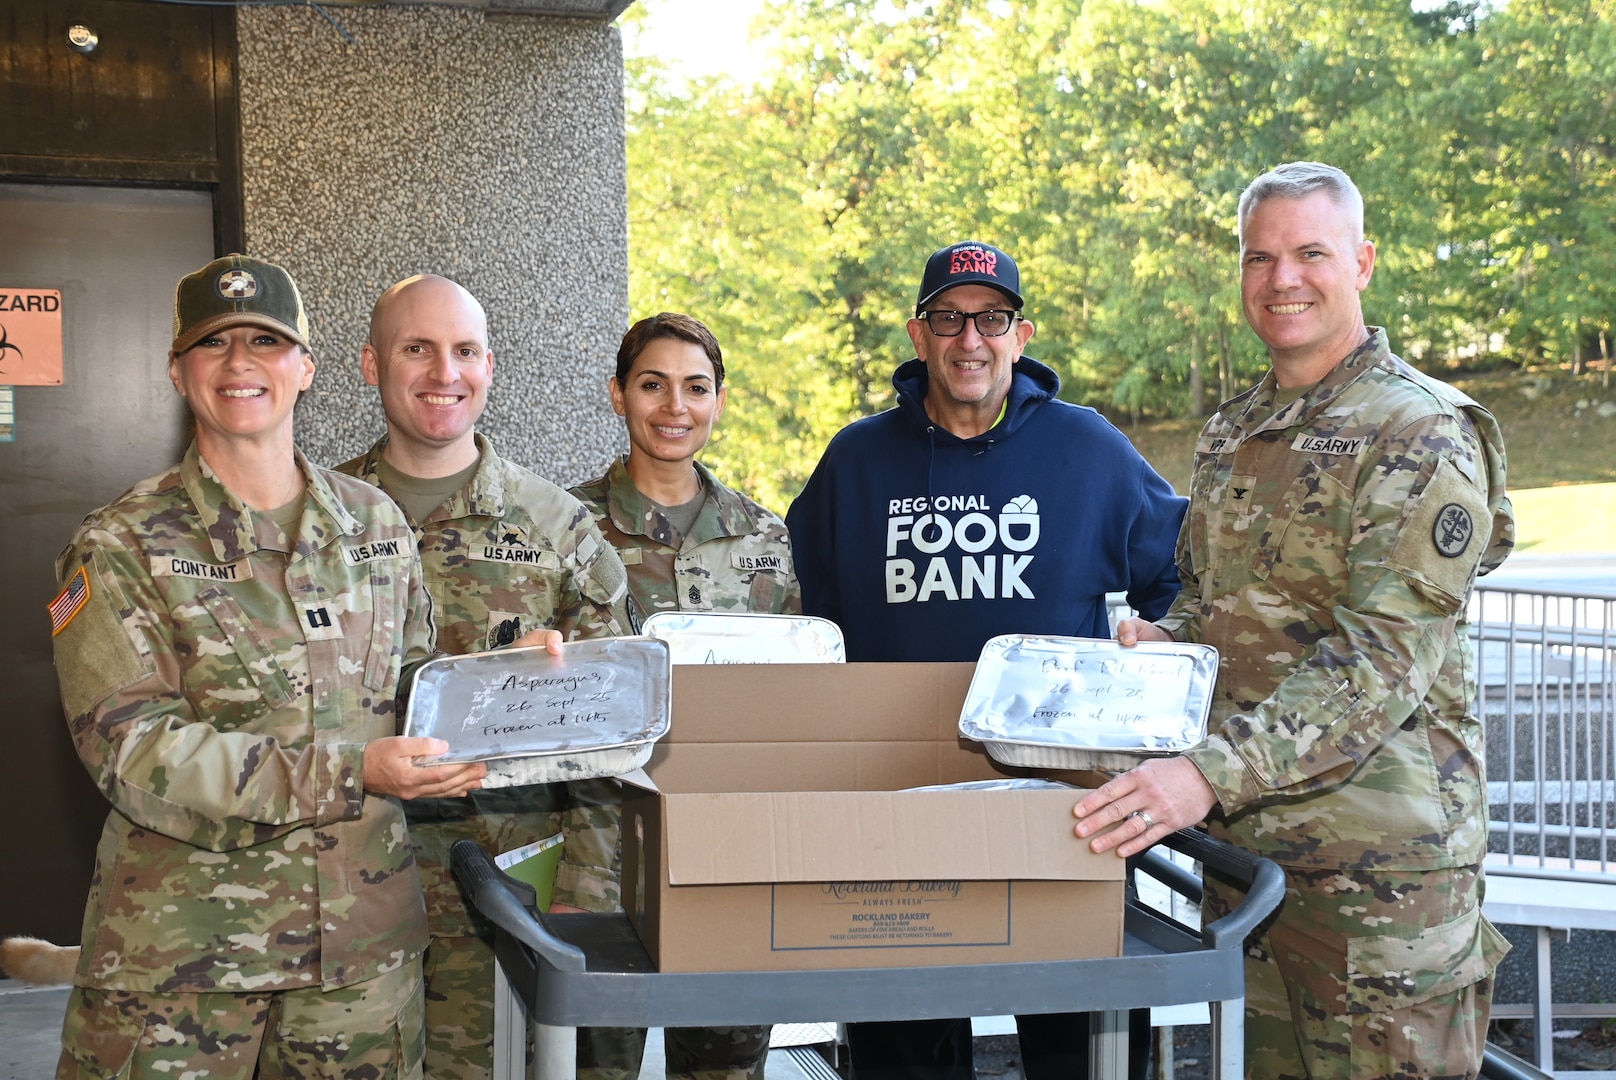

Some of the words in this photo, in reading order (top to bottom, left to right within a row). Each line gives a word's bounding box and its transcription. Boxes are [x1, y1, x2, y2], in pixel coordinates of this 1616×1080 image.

[950, 250, 997, 265] FOOD
[949, 261, 998, 277] BANK
[888, 495, 990, 515] REGIONAL
[886, 512, 1040, 557] FOOD
[171, 559, 237, 580] CONTANT
[885, 554, 1035, 603] BANK
[501, 672, 601, 692] Asparagus
[1048, 682, 1070, 694] 26
[506, 700, 533, 713] 26
[545, 696, 579, 709] Sept
[1033, 706, 1076, 719] Frozen
[482, 723, 543, 736] Frozen
[547, 714, 566, 726] at
[862, 898, 894, 906] ALWAYS
[897, 898, 922, 906] FRESH
[852, 913, 898, 922] ROCKLAND
[899, 912, 930, 921] BAKERY
